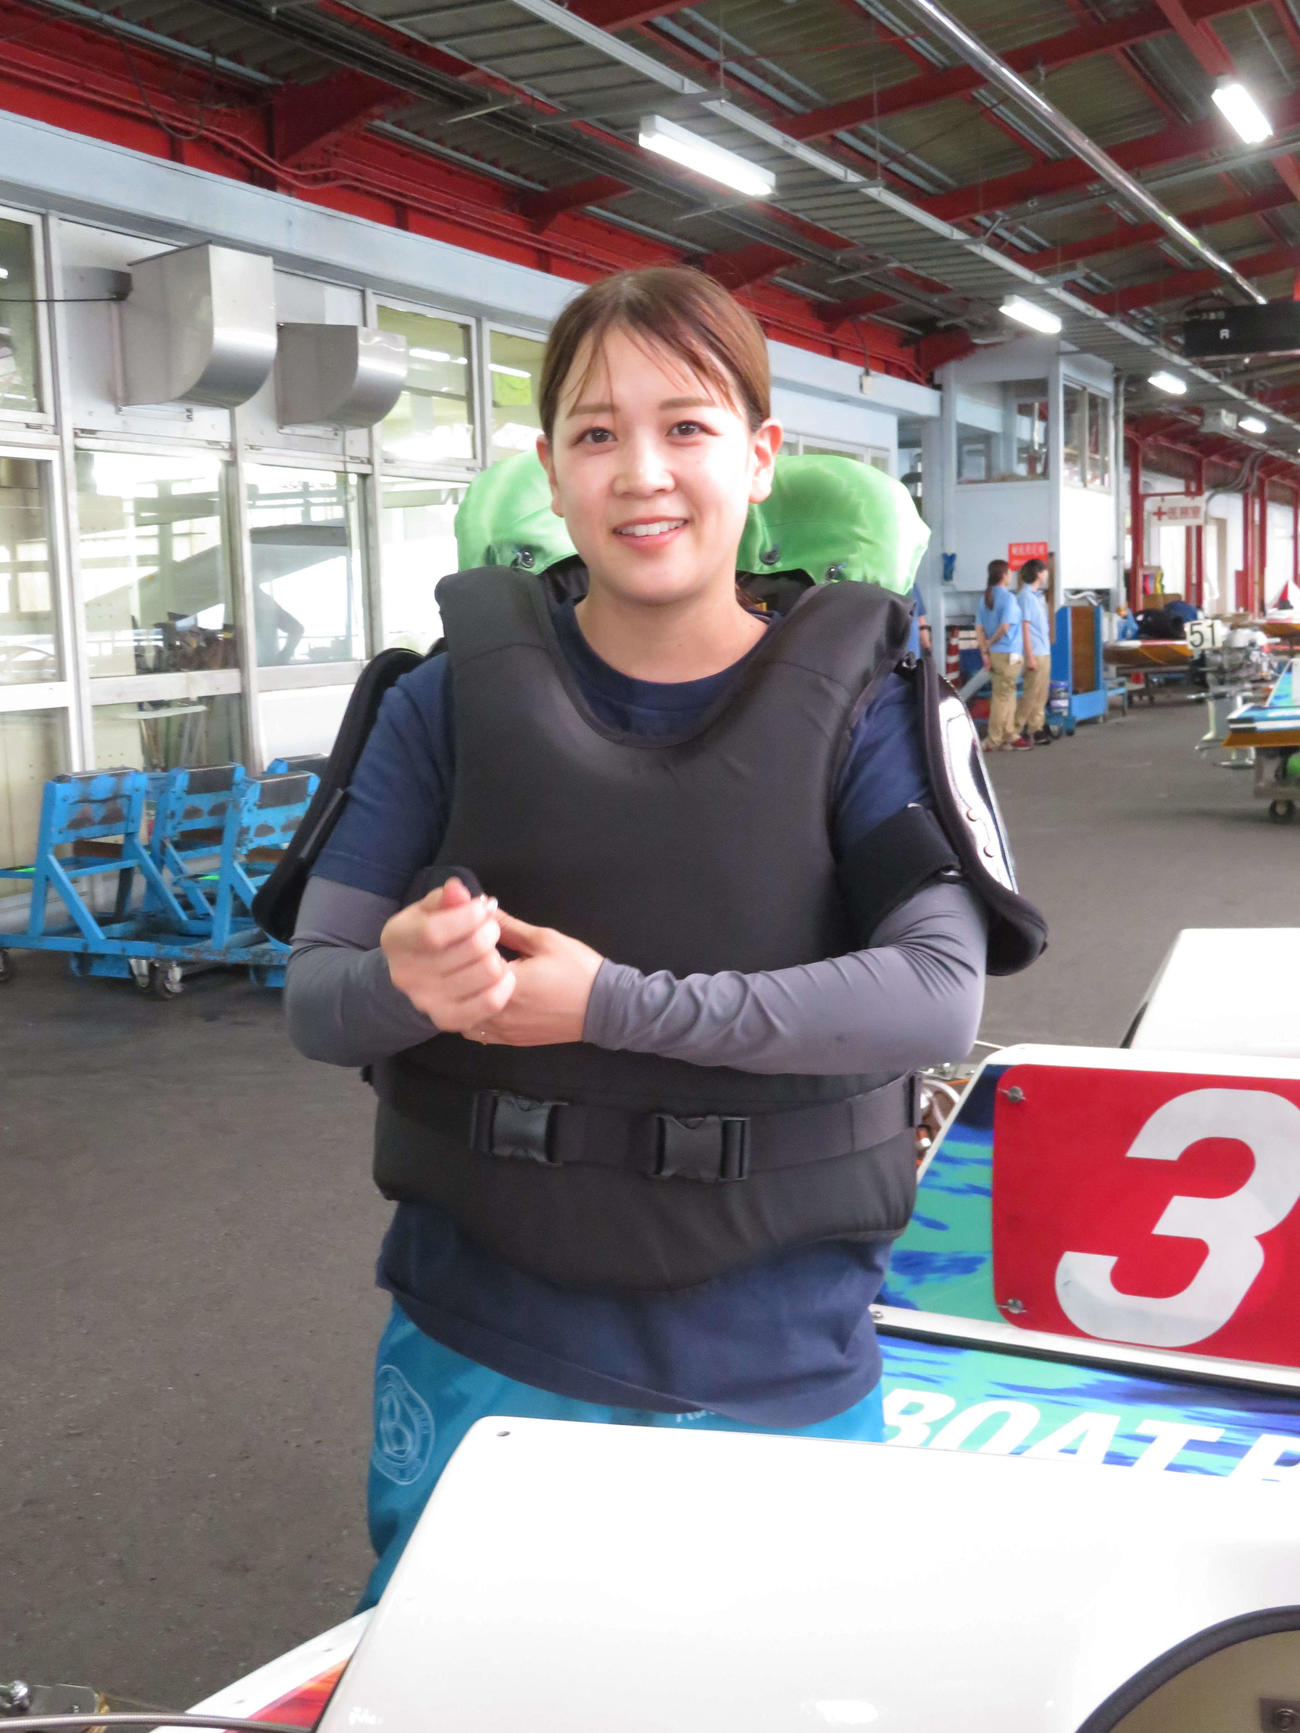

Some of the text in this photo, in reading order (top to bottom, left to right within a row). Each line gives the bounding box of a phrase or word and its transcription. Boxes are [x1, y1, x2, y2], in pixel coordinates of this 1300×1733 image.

[1190, 621, 1216, 648] 51
[1055, 1087, 1300, 1347] 3
[882, 1387, 1226, 1479] BOAT
